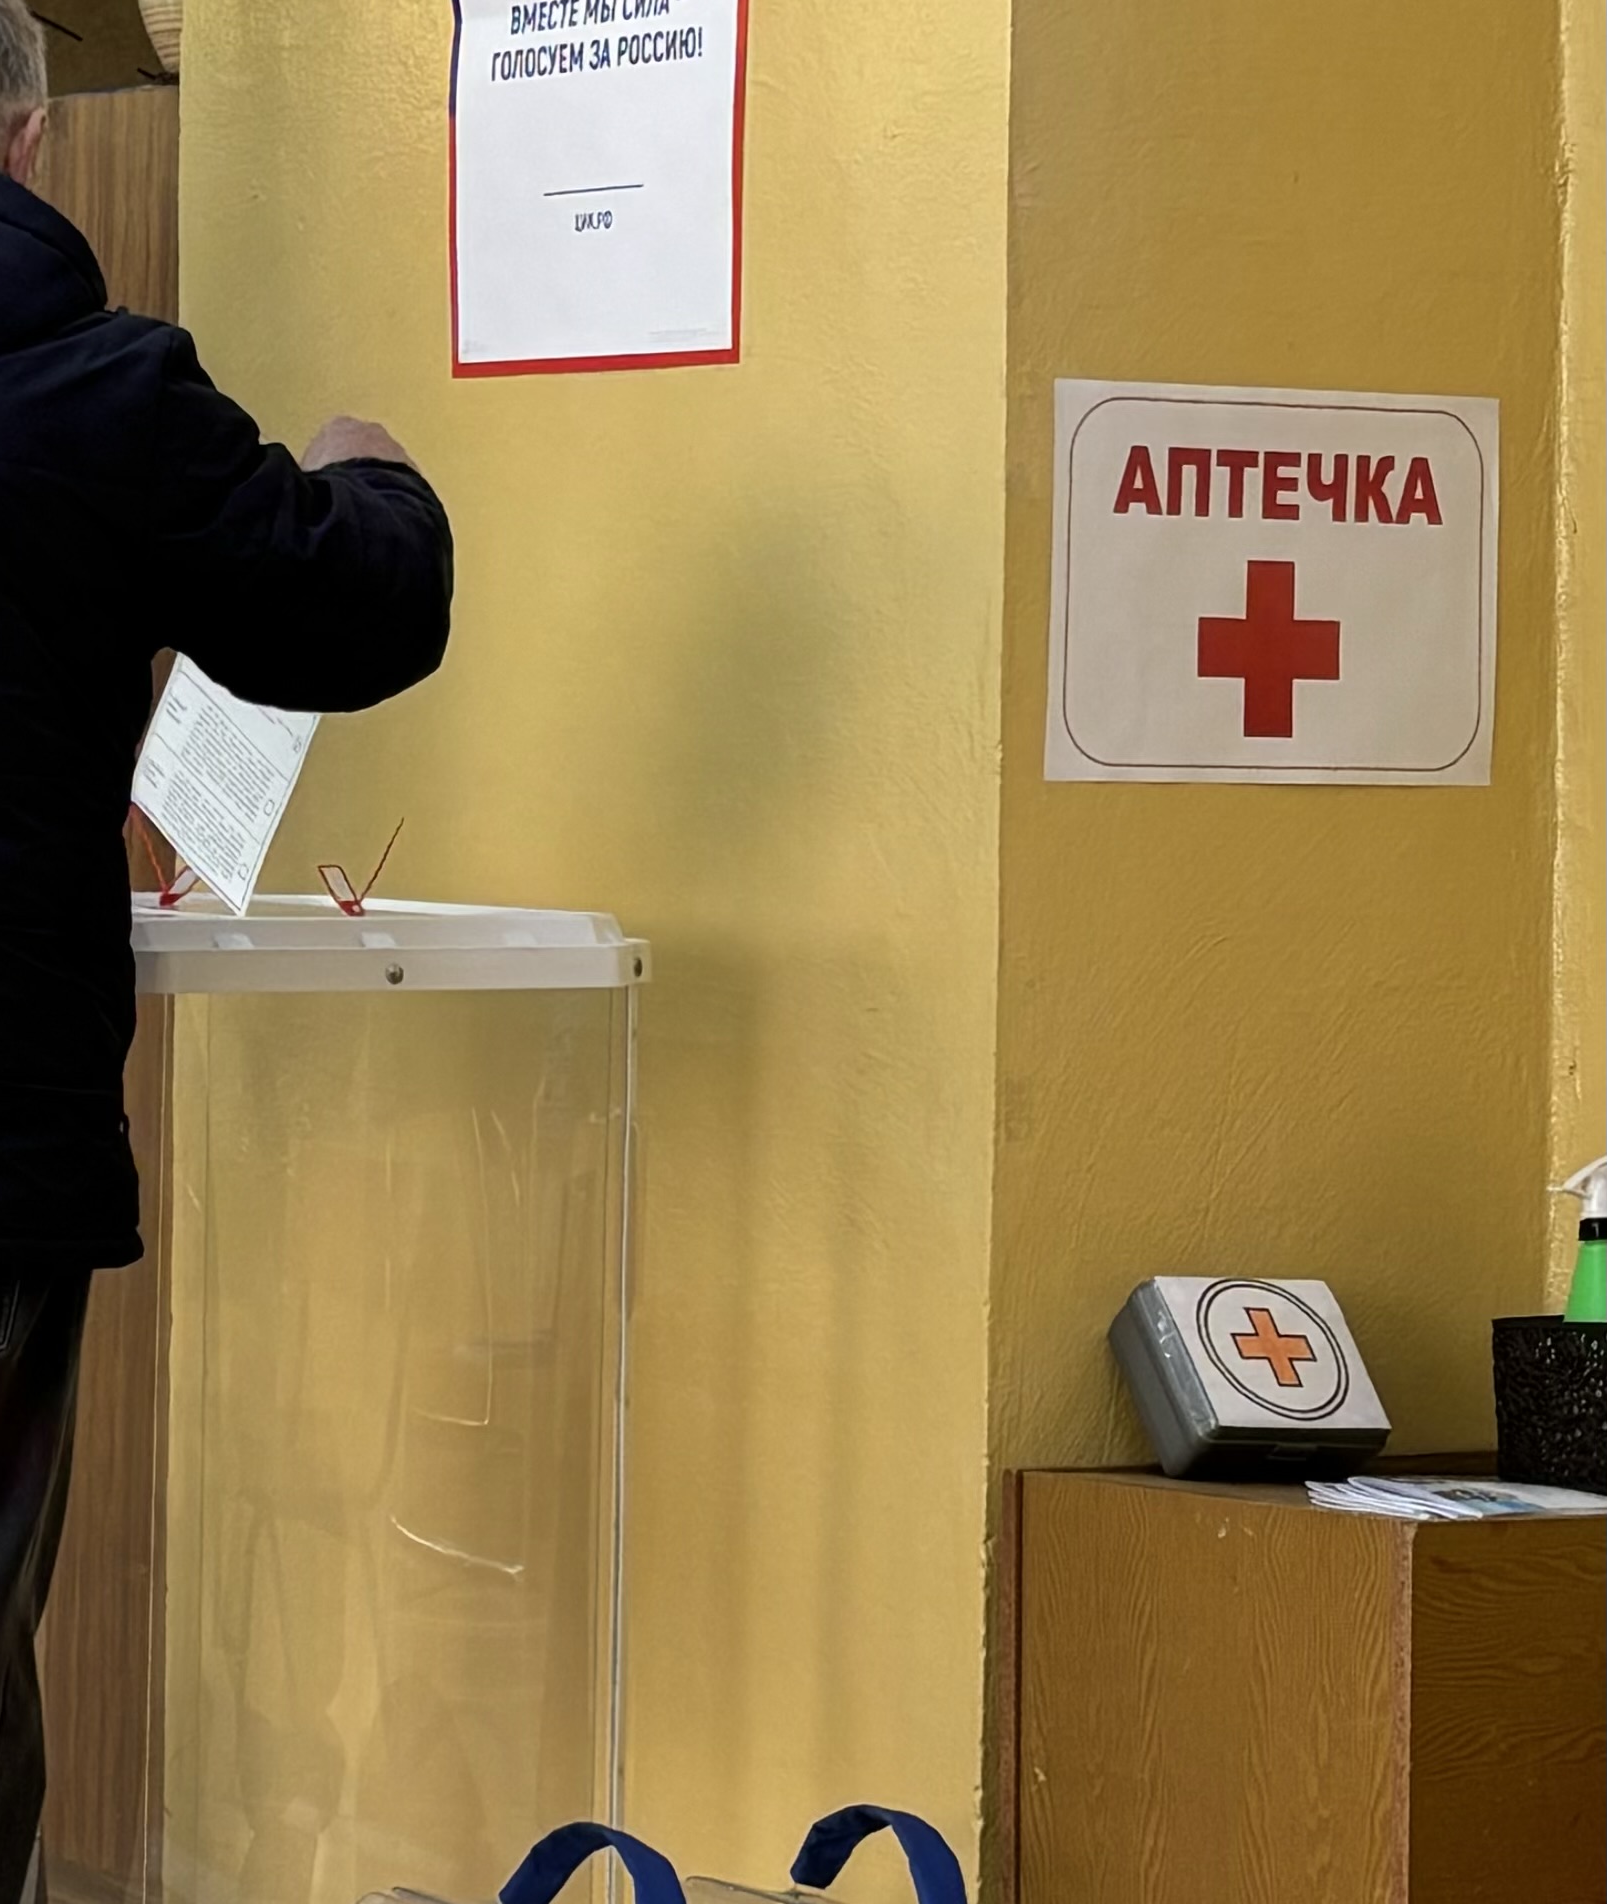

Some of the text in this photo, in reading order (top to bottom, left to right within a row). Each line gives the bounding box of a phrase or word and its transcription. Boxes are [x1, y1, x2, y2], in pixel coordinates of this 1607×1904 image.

[491, 26, 703, 82] ГОЛОСУЕМ ЗА РОССИЮ!
[1113, 444, 1444, 526] АПТЕЧКА
